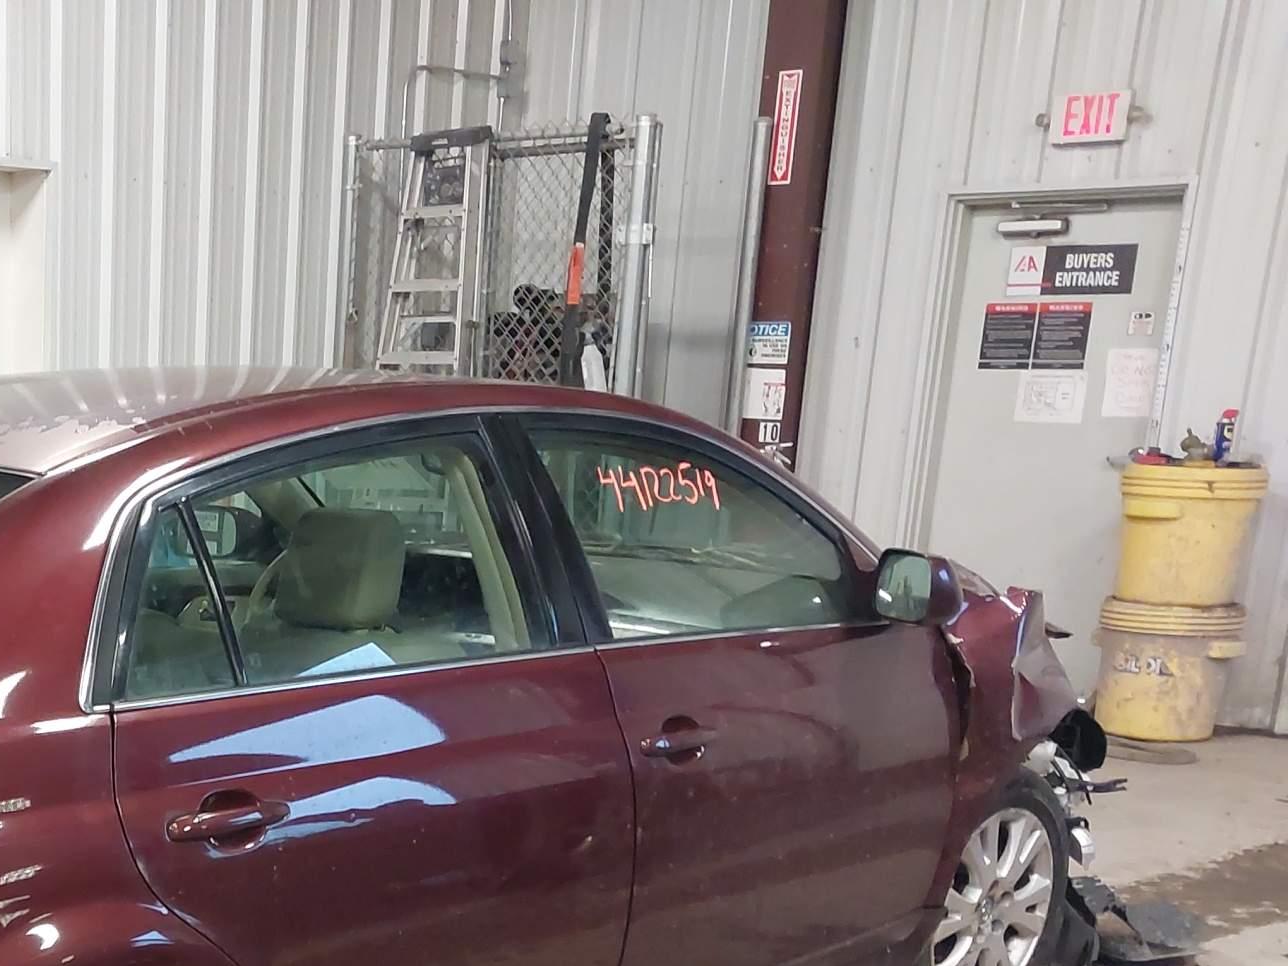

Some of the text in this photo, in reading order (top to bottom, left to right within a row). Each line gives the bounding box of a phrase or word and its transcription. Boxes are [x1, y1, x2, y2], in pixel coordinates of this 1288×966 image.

[1062, 93, 1121, 136] EXIT
[1065, 252, 1115, 269] BUYERS
[1055, 271, 1121, 288] ENTRANCE
[749, 324, 788, 336] OTICE
[763, 423, 778, 441] 10
